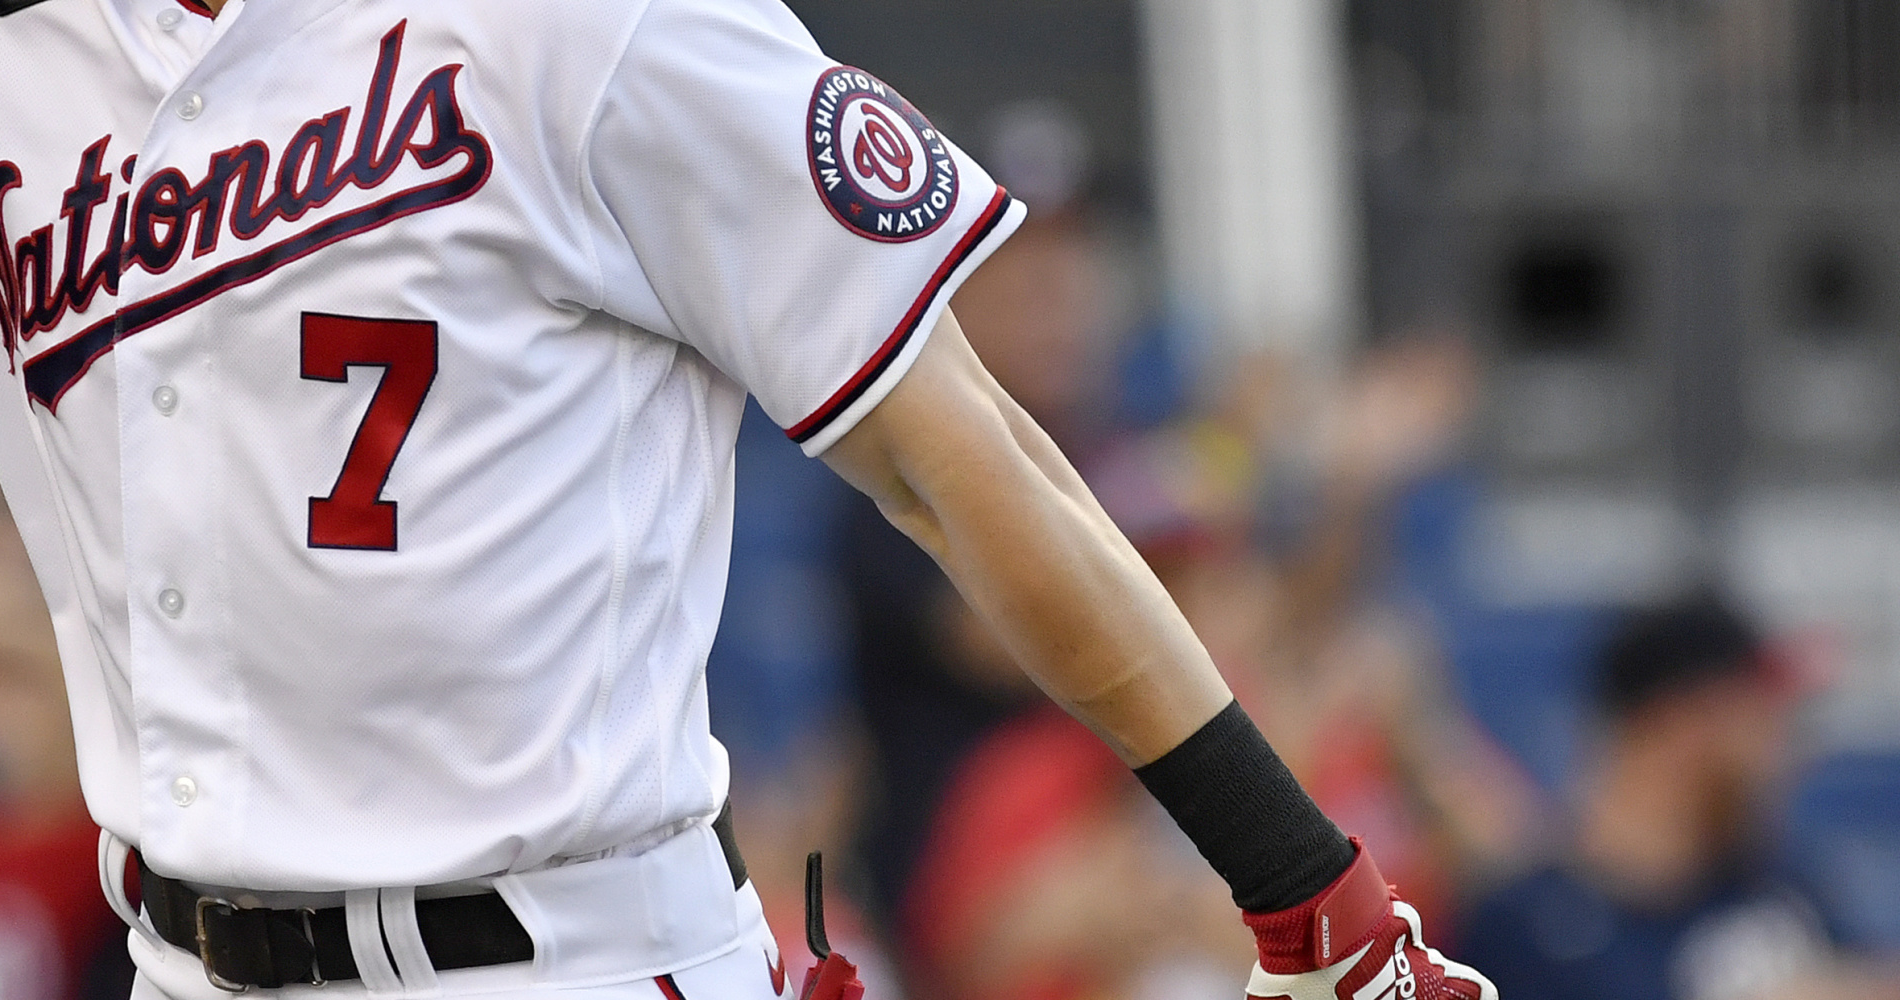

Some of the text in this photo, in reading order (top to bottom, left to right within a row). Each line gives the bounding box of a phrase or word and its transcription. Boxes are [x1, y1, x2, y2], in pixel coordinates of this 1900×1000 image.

[814, 72, 886, 192] WASHINGTON
[876, 127, 955, 233] NATIONALS
[300, 311, 438, 551] 7
